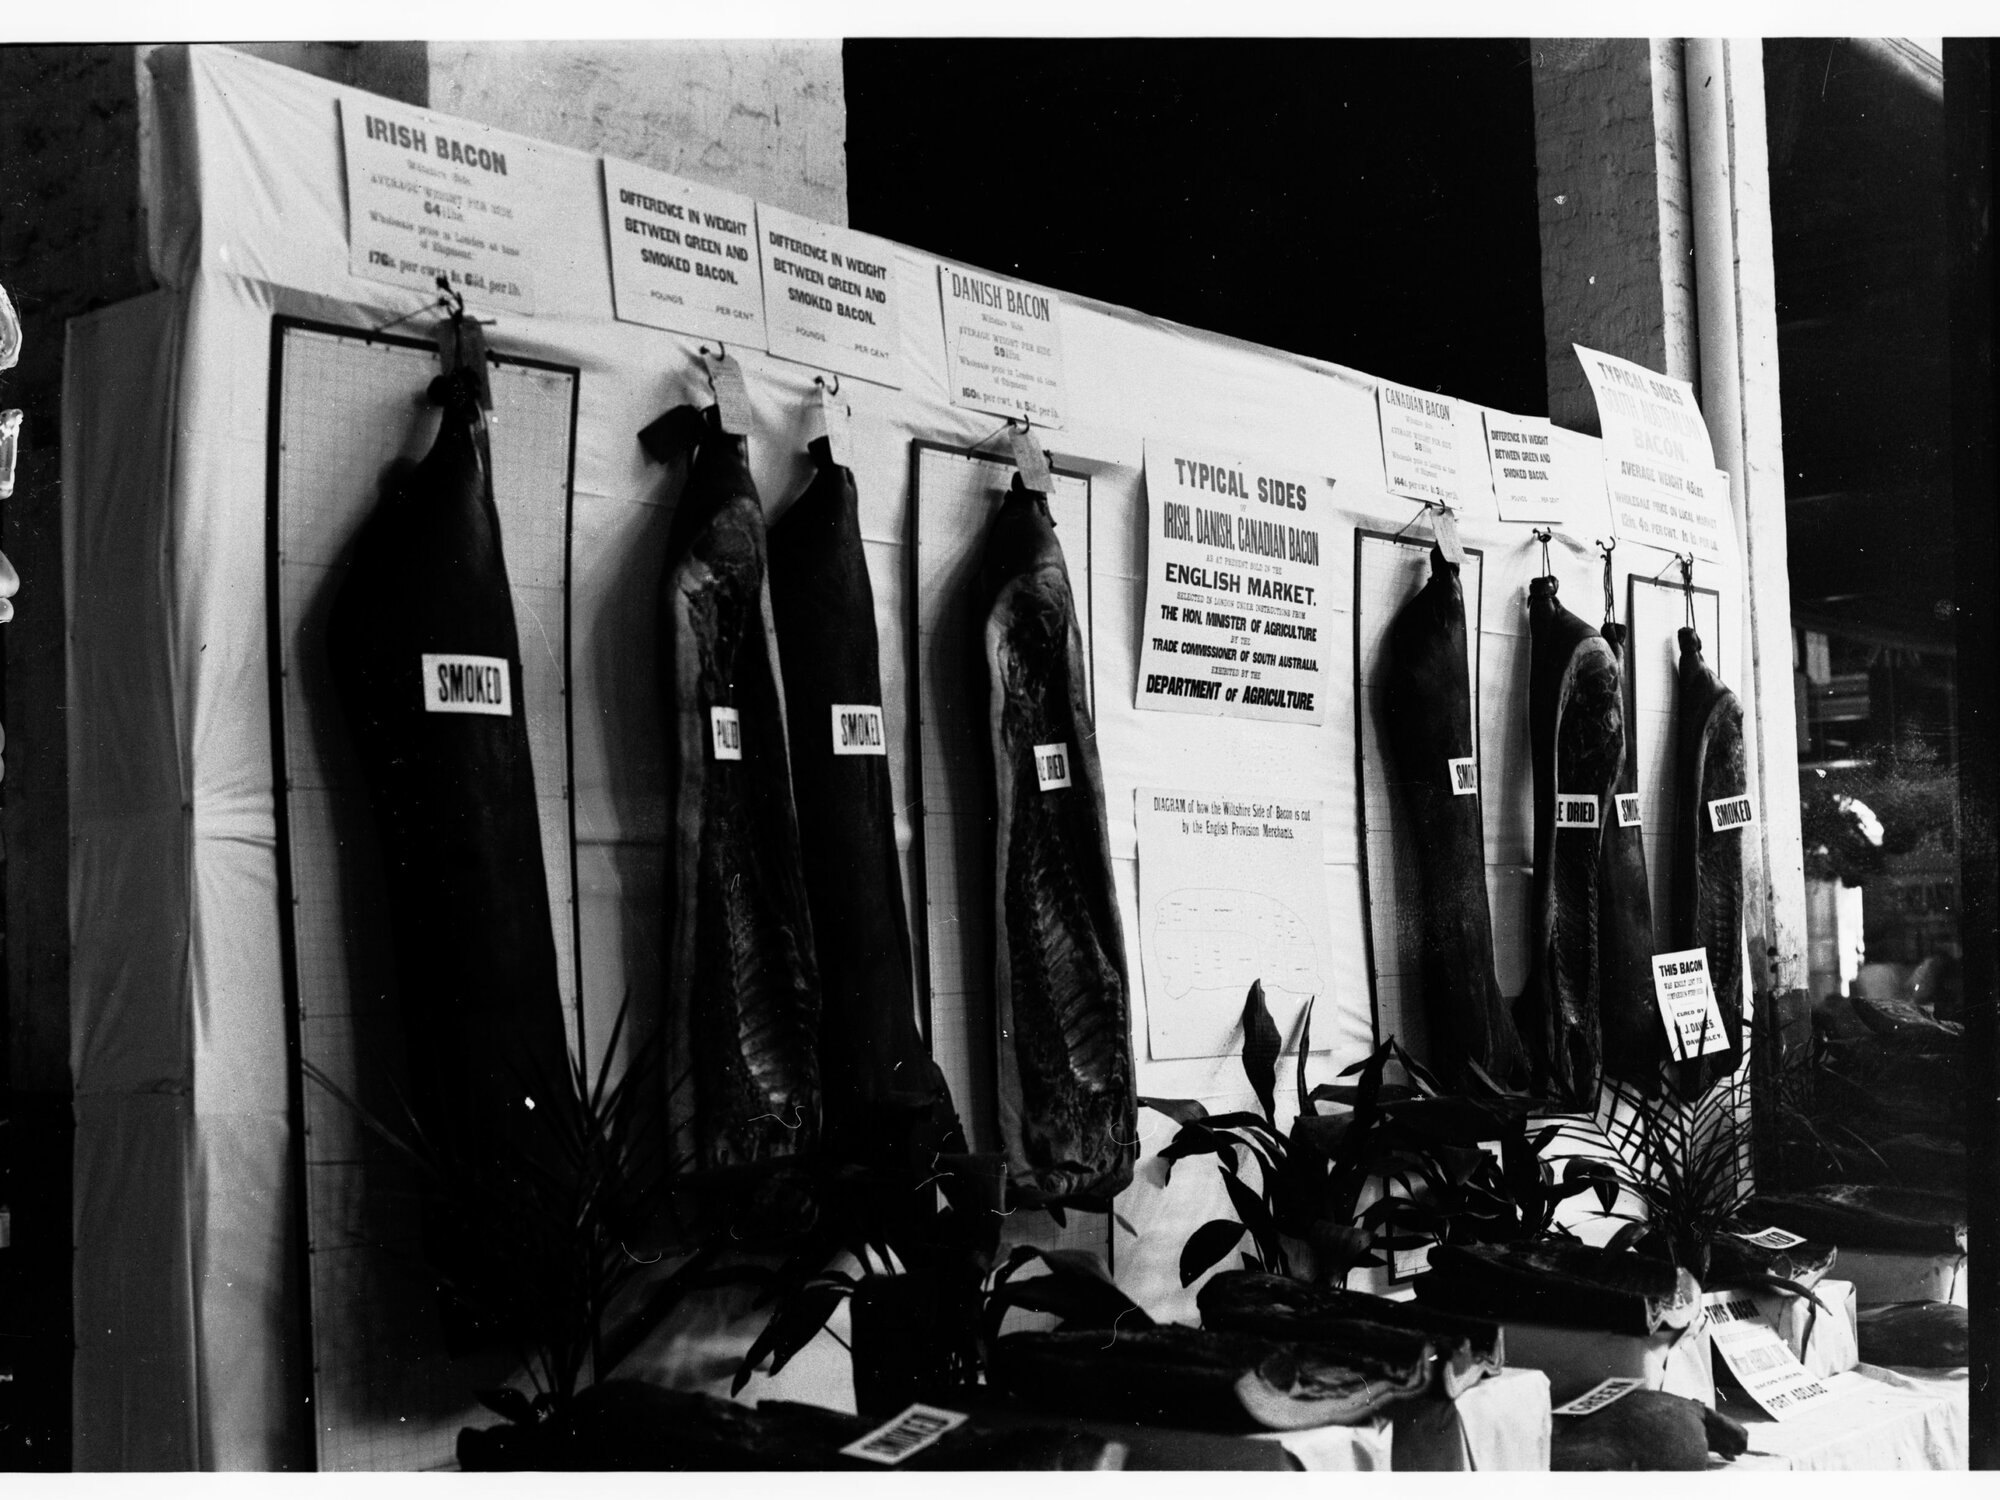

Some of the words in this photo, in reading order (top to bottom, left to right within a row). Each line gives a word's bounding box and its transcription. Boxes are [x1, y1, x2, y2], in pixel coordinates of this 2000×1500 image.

[365, 114, 427, 153] IRISH
[435, 135, 508, 176] BACON
[619, 188, 684, 220] DIFFERENCE
[688, 208, 700, 224] IN
[704, 212, 747, 236] WEIGHT
[625, 217, 681, 245] BETWEEN
[685, 233, 722, 256] GREEN
[726, 244, 749, 262] AND
[641, 248, 691, 273] SMOKED
[695, 262, 739, 286] BACON.
[769, 231, 828, 263] DIFFERENCE
[831, 252, 843, 268] IN
[846, 256, 887, 280] WEIGHT
[773, 257, 824, 286] BETWEEN
[827, 275, 861, 298] GREEN
[865, 287, 886, 304] AND
[715, 305, 731, 316] PER
[788, 287, 833, 313] SMOKED
[837, 302, 876, 326] BACON.
[952, 273, 1002, 310] DANISH
[1006, 288, 1050, 322] BACON
[1597, 361, 1649, 394] TYPICAL
[1649, 379, 1684, 406] SIDES
[1385, 388, 1424, 413] CANADIAN
[1425, 400, 1450, 421] BACON
[1491, 430, 1520, 443] DIFFERENCE
[1521, 433, 1528, 444] IN
[1528, 434, 1548, 446] WEIGHT
[1494, 448, 1520, 461] BETWEEN
[1521, 451, 1539, 462] GREEN
[1540, 453, 1551, 464] AND
[1174, 457, 1249, 500] TYPICAL
[1257, 476, 1307, 512] SIDES
[1503, 467, 1527, 480] SMOKED
[1621, 461, 1656, 483] AVERAGE
[1658, 470, 1684, 492] WEIGHT
[1614, 491, 1650, 510] WHOLESALE
[1652, 501, 1669, 515] PRICE
[1678, 508, 1694, 522] LOCAL
[1237, 516, 1286, 560] CANADIAN
[1288, 526, 1319, 567] BACON
[1224, 556, 1248, 569] PRESENT
[1272, 564, 1283, 575] THE
[1165, 562, 1241, 593] ENGLISH
[1247, 576, 1317, 606] MARKET.
[1176, 591, 1205, 604] SELECTED
[1214, 597, 1235, 608] LONDON
[1236, 599, 1253, 611] UNDER
[1255, 602, 1291, 617] INSTRUCTIONS
[1292, 609, 1306, 620] FROM
[1161, 604, 1178, 621] THE
[1182, 608, 1203, 625] HON.
[1206, 611, 1246, 632] MINISTER
[1250, 618, 1262, 634] OF
[1263, 621, 1317, 642] AGRICULTURE
[1152, 638, 1178, 653] TRADE
[1181, 642, 1237, 661] COMMISSIONER
[1240, 650, 1250, 662] OF
[1252, 651, 1276, 666] SOUTH
[1230, 635, 1239, 645] BY
[1240, 637, 1251, 646] THE
[438, 664, 501, 704] SMOKED
[1211, 665, 1239, 678] EXHIBITED
[1241, 668, 1249, 679] BY
[1250, 670, 1261, 680] THE
[1146, 674, 1222, 700] DEPARTMENT
[1225, 687, 1239, 702] OF
[841, 713, 881, 746] SMOKED
[1154, 797, 1186, 813] DIAGRAM
[1188, 800, 1194, 813] of
[1196, 800, 1209, 814] how
[1211, 801, 1221, 815] the
[1223, 802, 1251, 817] Wiltshire
[1252, 804, 1265, 818] Side
[1266, 805, 1273, 818] of
[1276, 806, 1293, 820] Bacon
[1294, 808, 1300, 821] is
[1301, 809, 1311, 821] cut
[1557, 801, 1563, 822] E
[1566, 801, 1595, 823] DRIED
[1715, 799, 1752, 827] SMOKED
[1182, 819, 1189, 834] by
[1193, 820, 1202, 834] the
[1206, 820, 1228, 836] English
[1231, 822, 1259, 836] Provision
[1658, 963, 1678, 977] THIS
[1679, 959, 1703, 975] BACON
[1691, 1019, 1715, 1034] DAVES
[1704, 1303, 1730, 1325] THIS
[1726, 1299, 1761, 1321] BACON
[1568, 1382, 1633, 1411] GREEN
[1766, 1394, 1793, 1411] PORT
